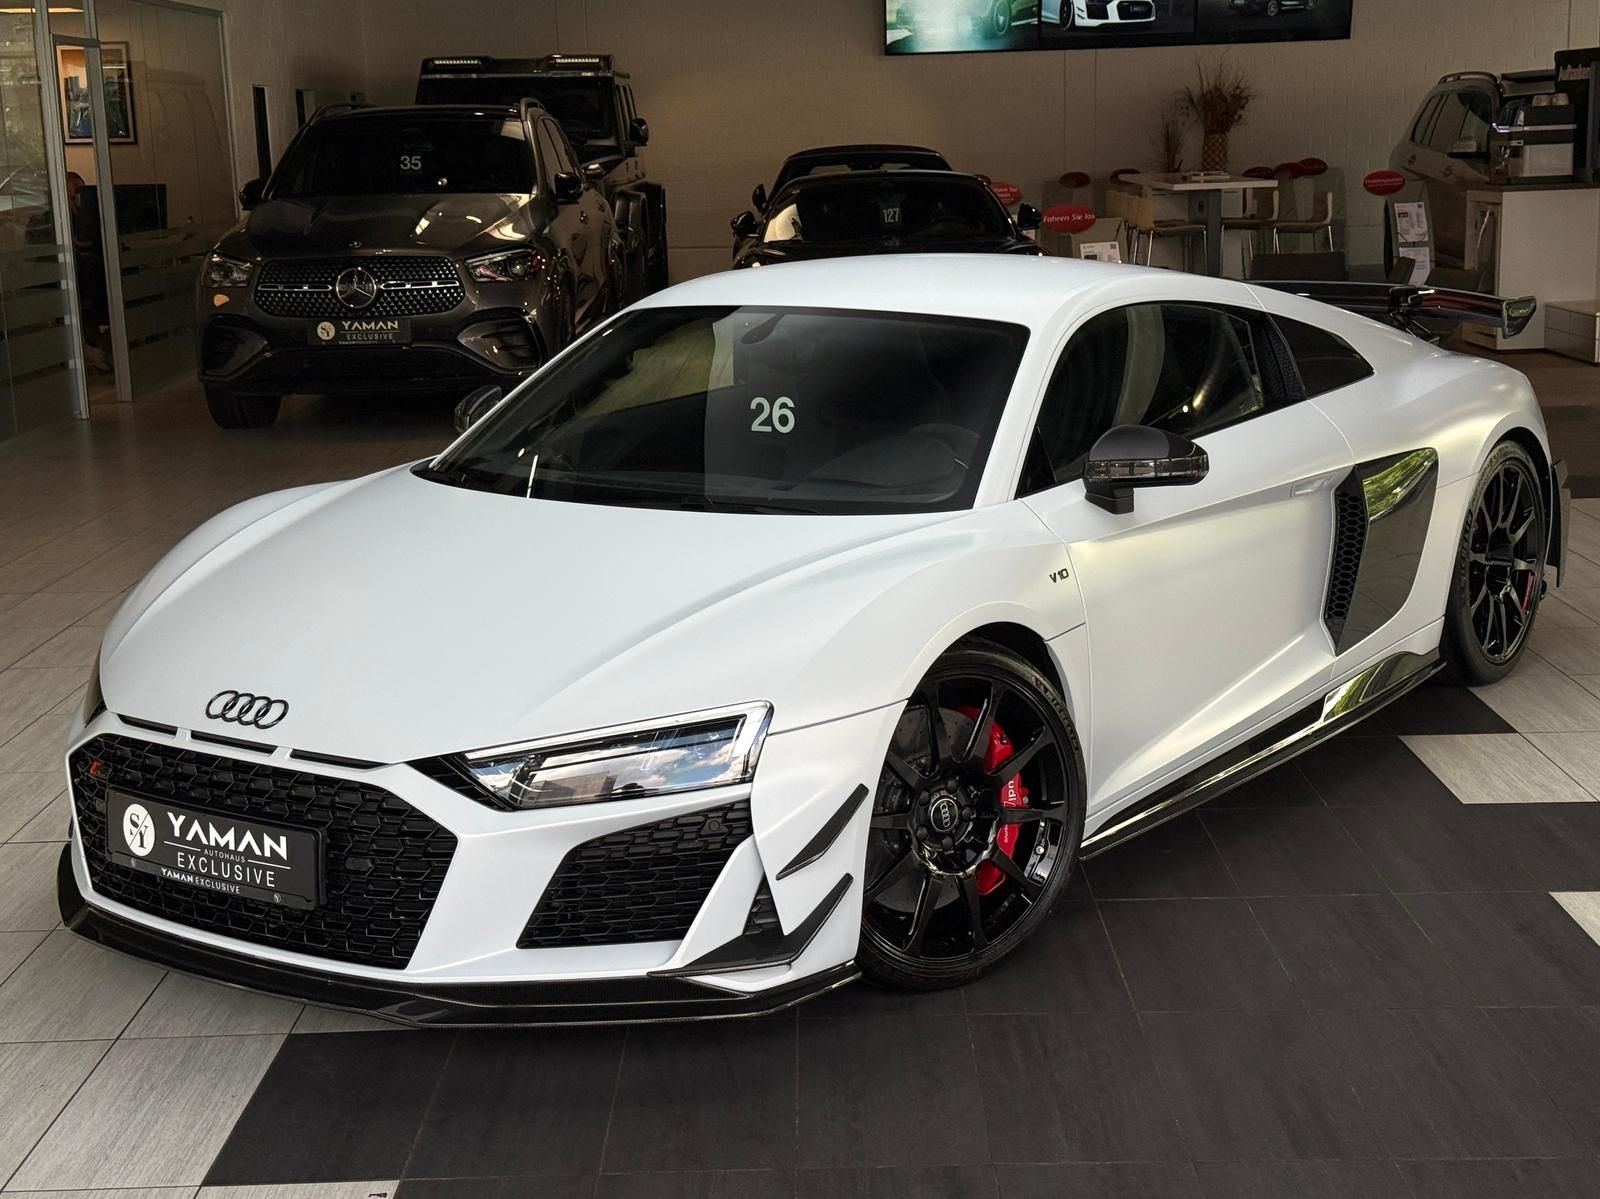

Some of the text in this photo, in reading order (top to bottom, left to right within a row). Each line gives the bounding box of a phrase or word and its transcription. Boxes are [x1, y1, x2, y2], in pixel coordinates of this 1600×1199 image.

[399, 155, 422, 170] 35
[883, 207, 900, 224] 127
[1043, 215, 1070, 223] Fahren
[1071, 213, 1083, 221] Sie
[341, 320, 399, 330] YAMAN
[750, 396, 796, 434] 26
[1049, 568, 1069, 583] V10
[167, 812, 288, 861] YAMAN
[203, 848, 246, 864] AUTOHAUS
[177, 851, 276, 888] EXCLUSIVE
[160, 867, 241, 895] YAMAN EXCLUSIVE
